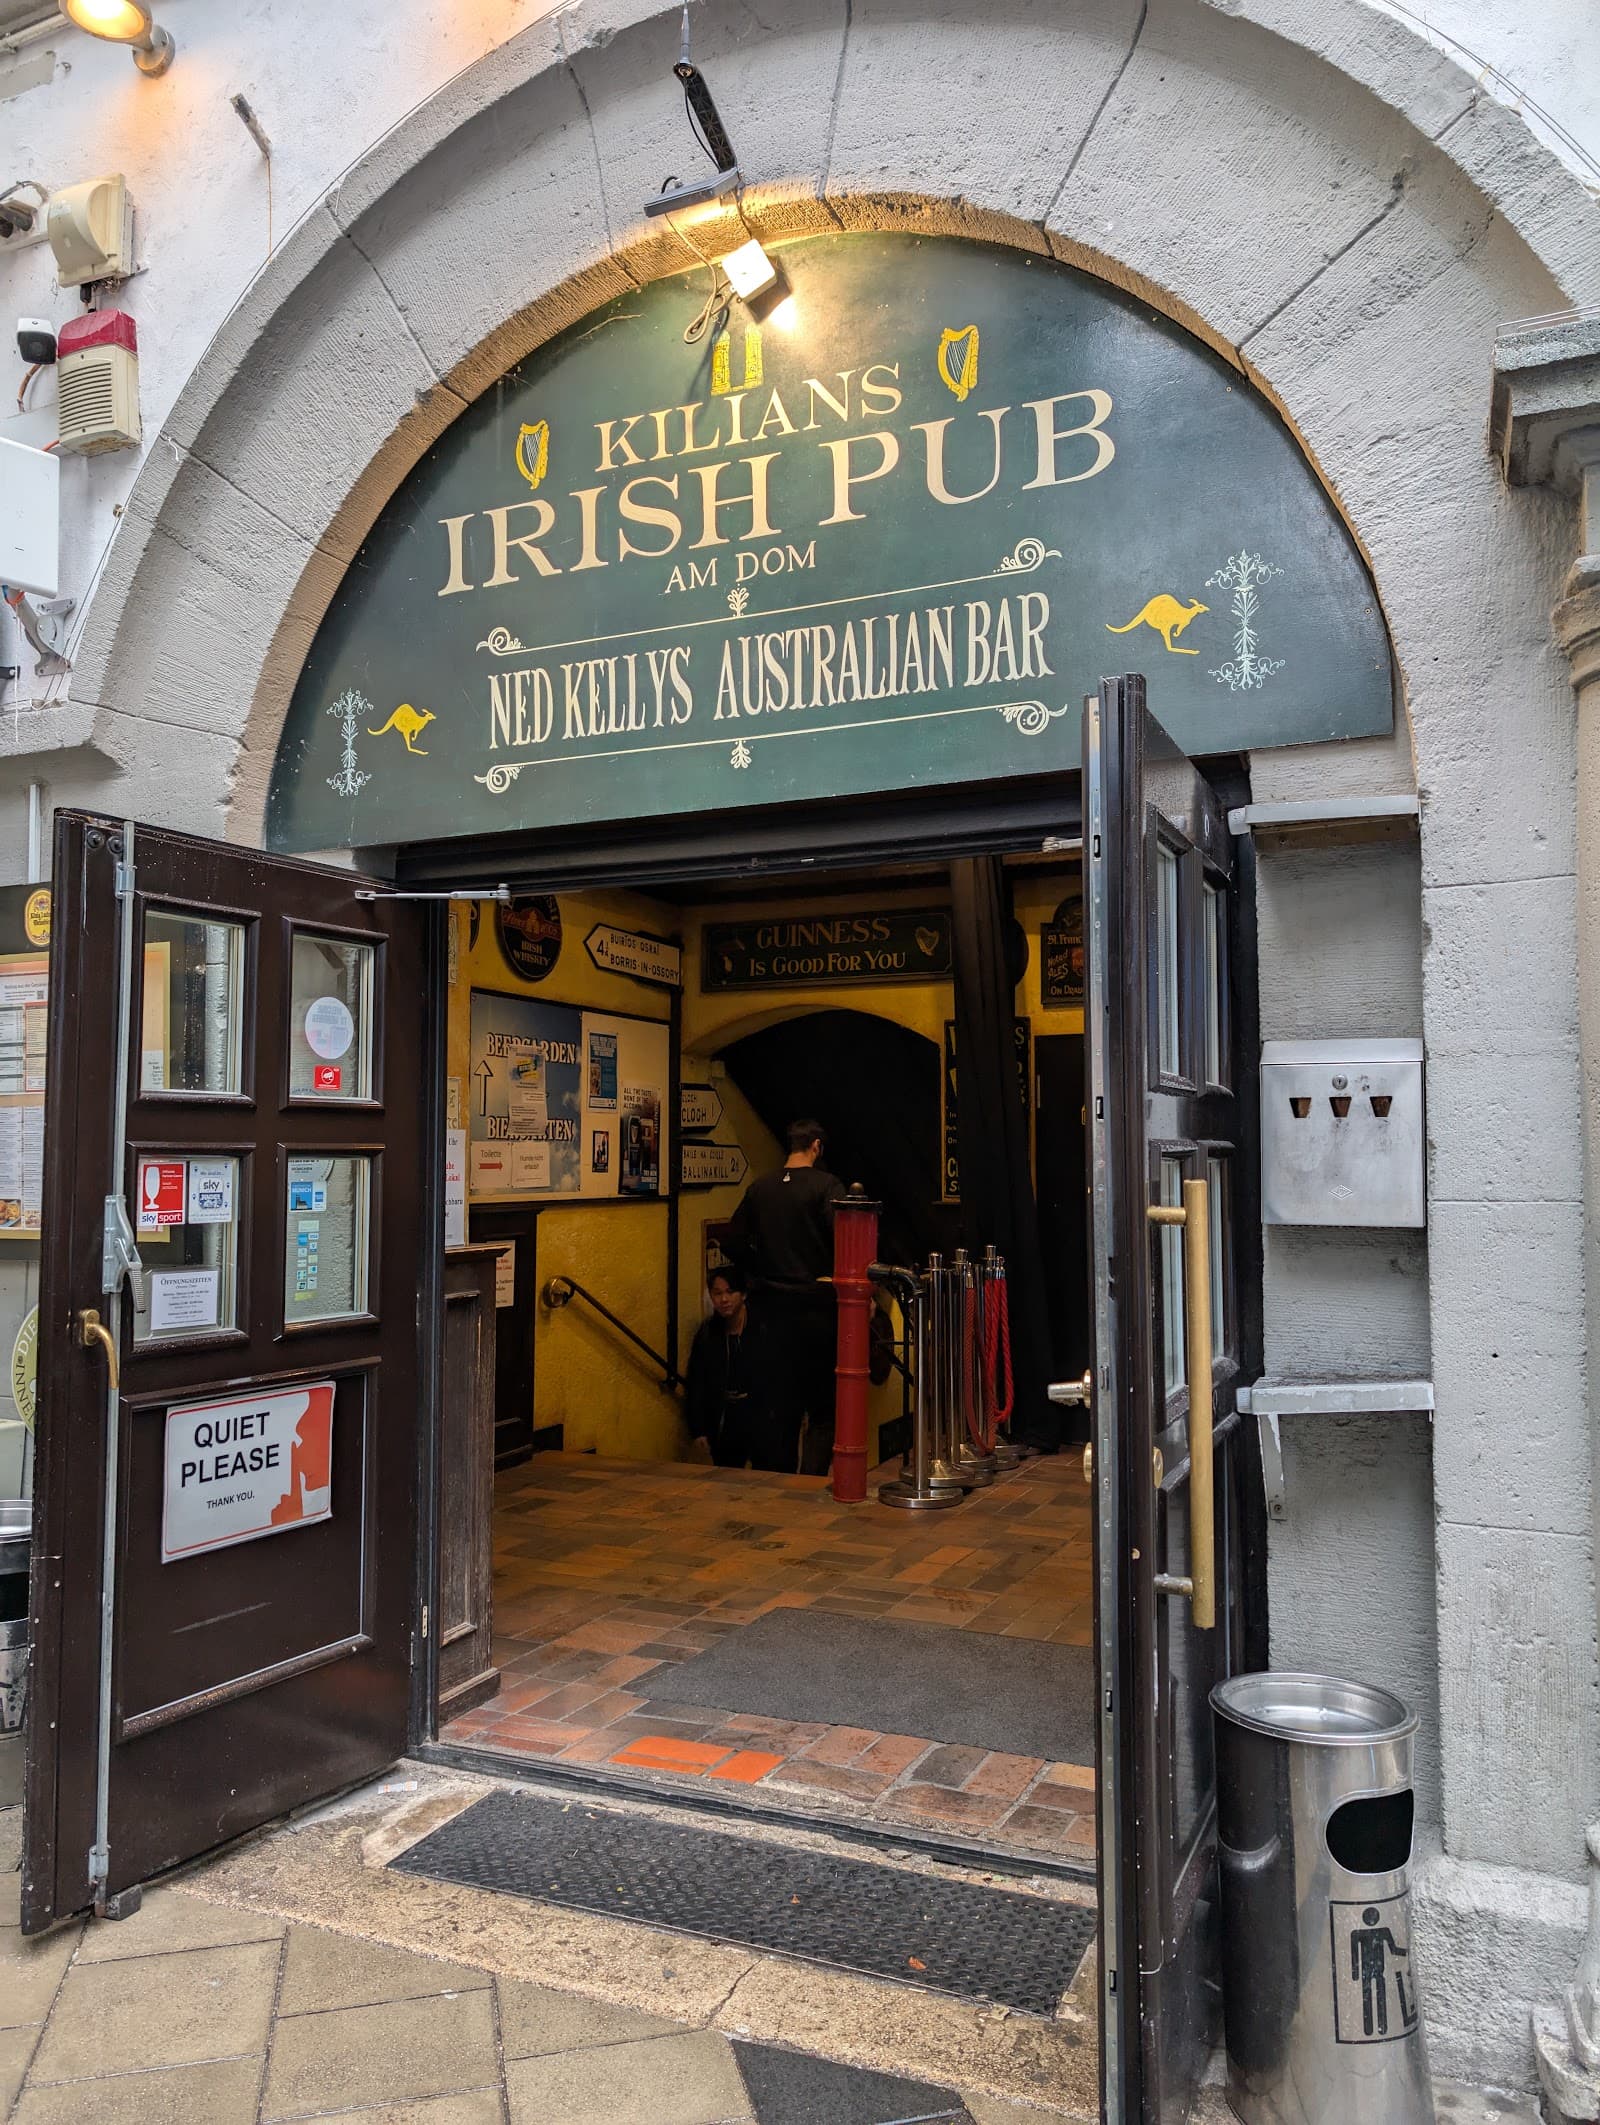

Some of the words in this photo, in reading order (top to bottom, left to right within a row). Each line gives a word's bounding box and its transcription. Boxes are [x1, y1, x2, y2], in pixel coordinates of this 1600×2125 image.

[595, 362, 902, 472] KILIANS
[437, 452, 783, 597] IRISH
[817, 389, 1116, 526] PUB
[664, 561, 718, 594] AM
[736, 540, 817, 583] DOM
[488, 667, 553, 750] NED
[562, 645, 693, 740] KELLYS
[712, 605, 955, 720] AUSTRALIAN
[964, 592, 1055, 684] BAR
[521, 940, 543, 955] IRISH
[756, 918, 891, 950] GUINNESS
[864, 950, 906, 970] YOU
[486, 1032, 577, 1065] BEERDEN
[487, 1115, 576, 1141] BIETEN
[203, 1180, 219, 1191] sky
[142, 1214, 156, 1223] sky
[159, 1213, 182, 1223] sport
[194, 1411, 270, 1449] QUIET
[181, 1443, 280, 1488] PLEASE
[206, 1494, 235, 1509] THANK
